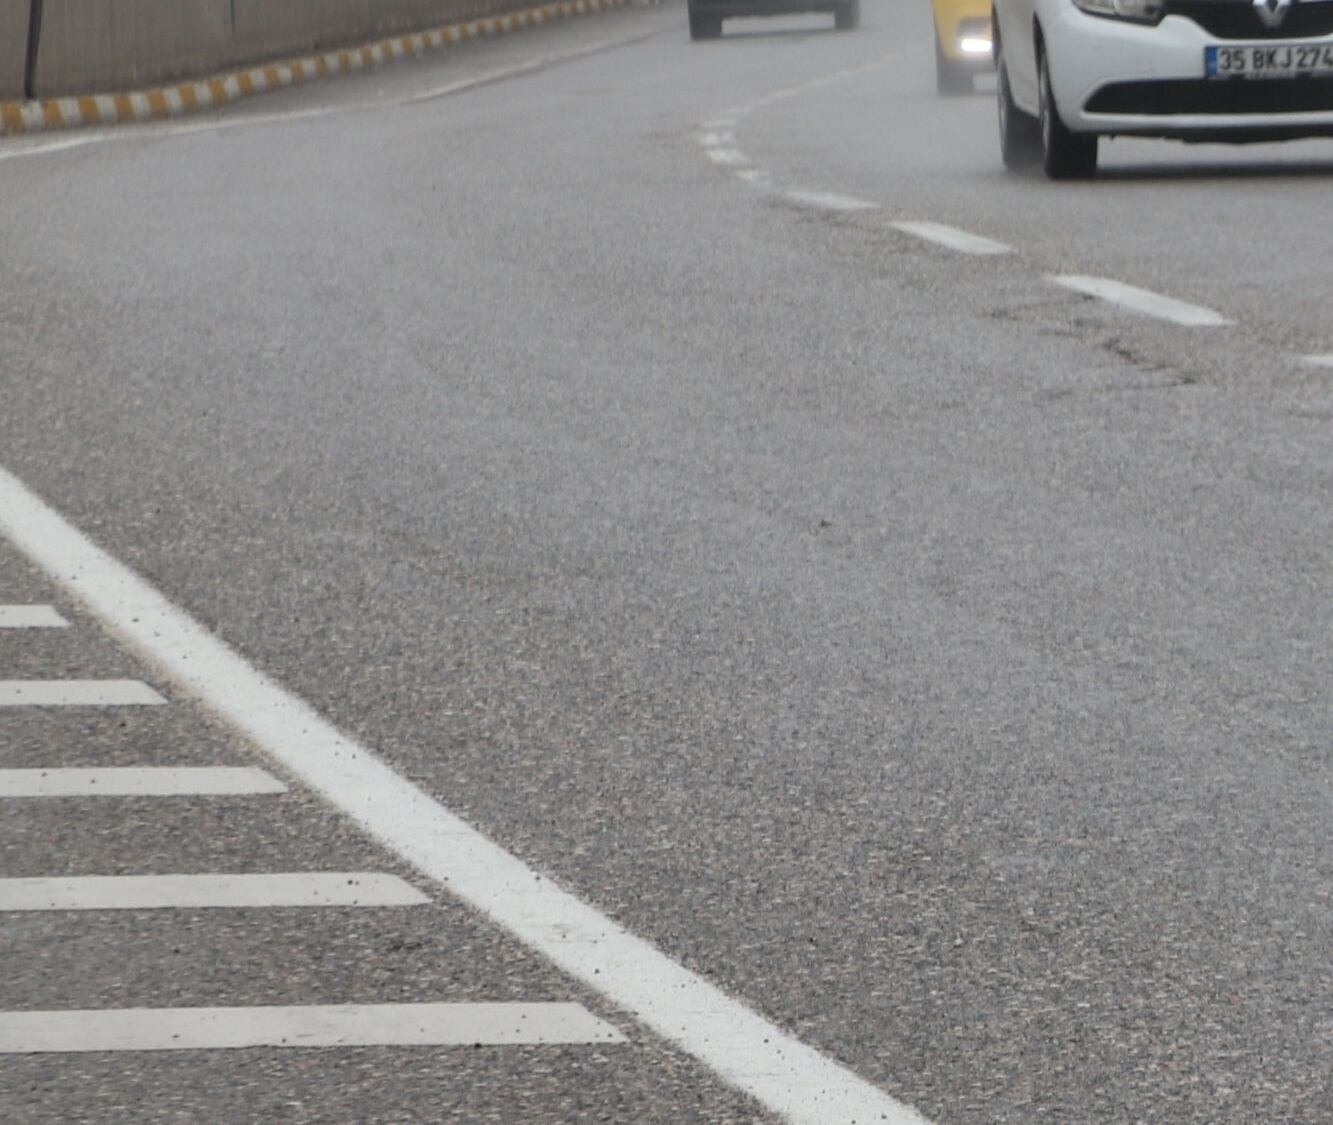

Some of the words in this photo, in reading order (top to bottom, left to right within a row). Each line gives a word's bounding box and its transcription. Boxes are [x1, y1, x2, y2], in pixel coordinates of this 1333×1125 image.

[1220, 49, 1245, 70] 35
[1253, 48, 1292, 69] BKJ
[1296, 46, 1333, 68] 274
